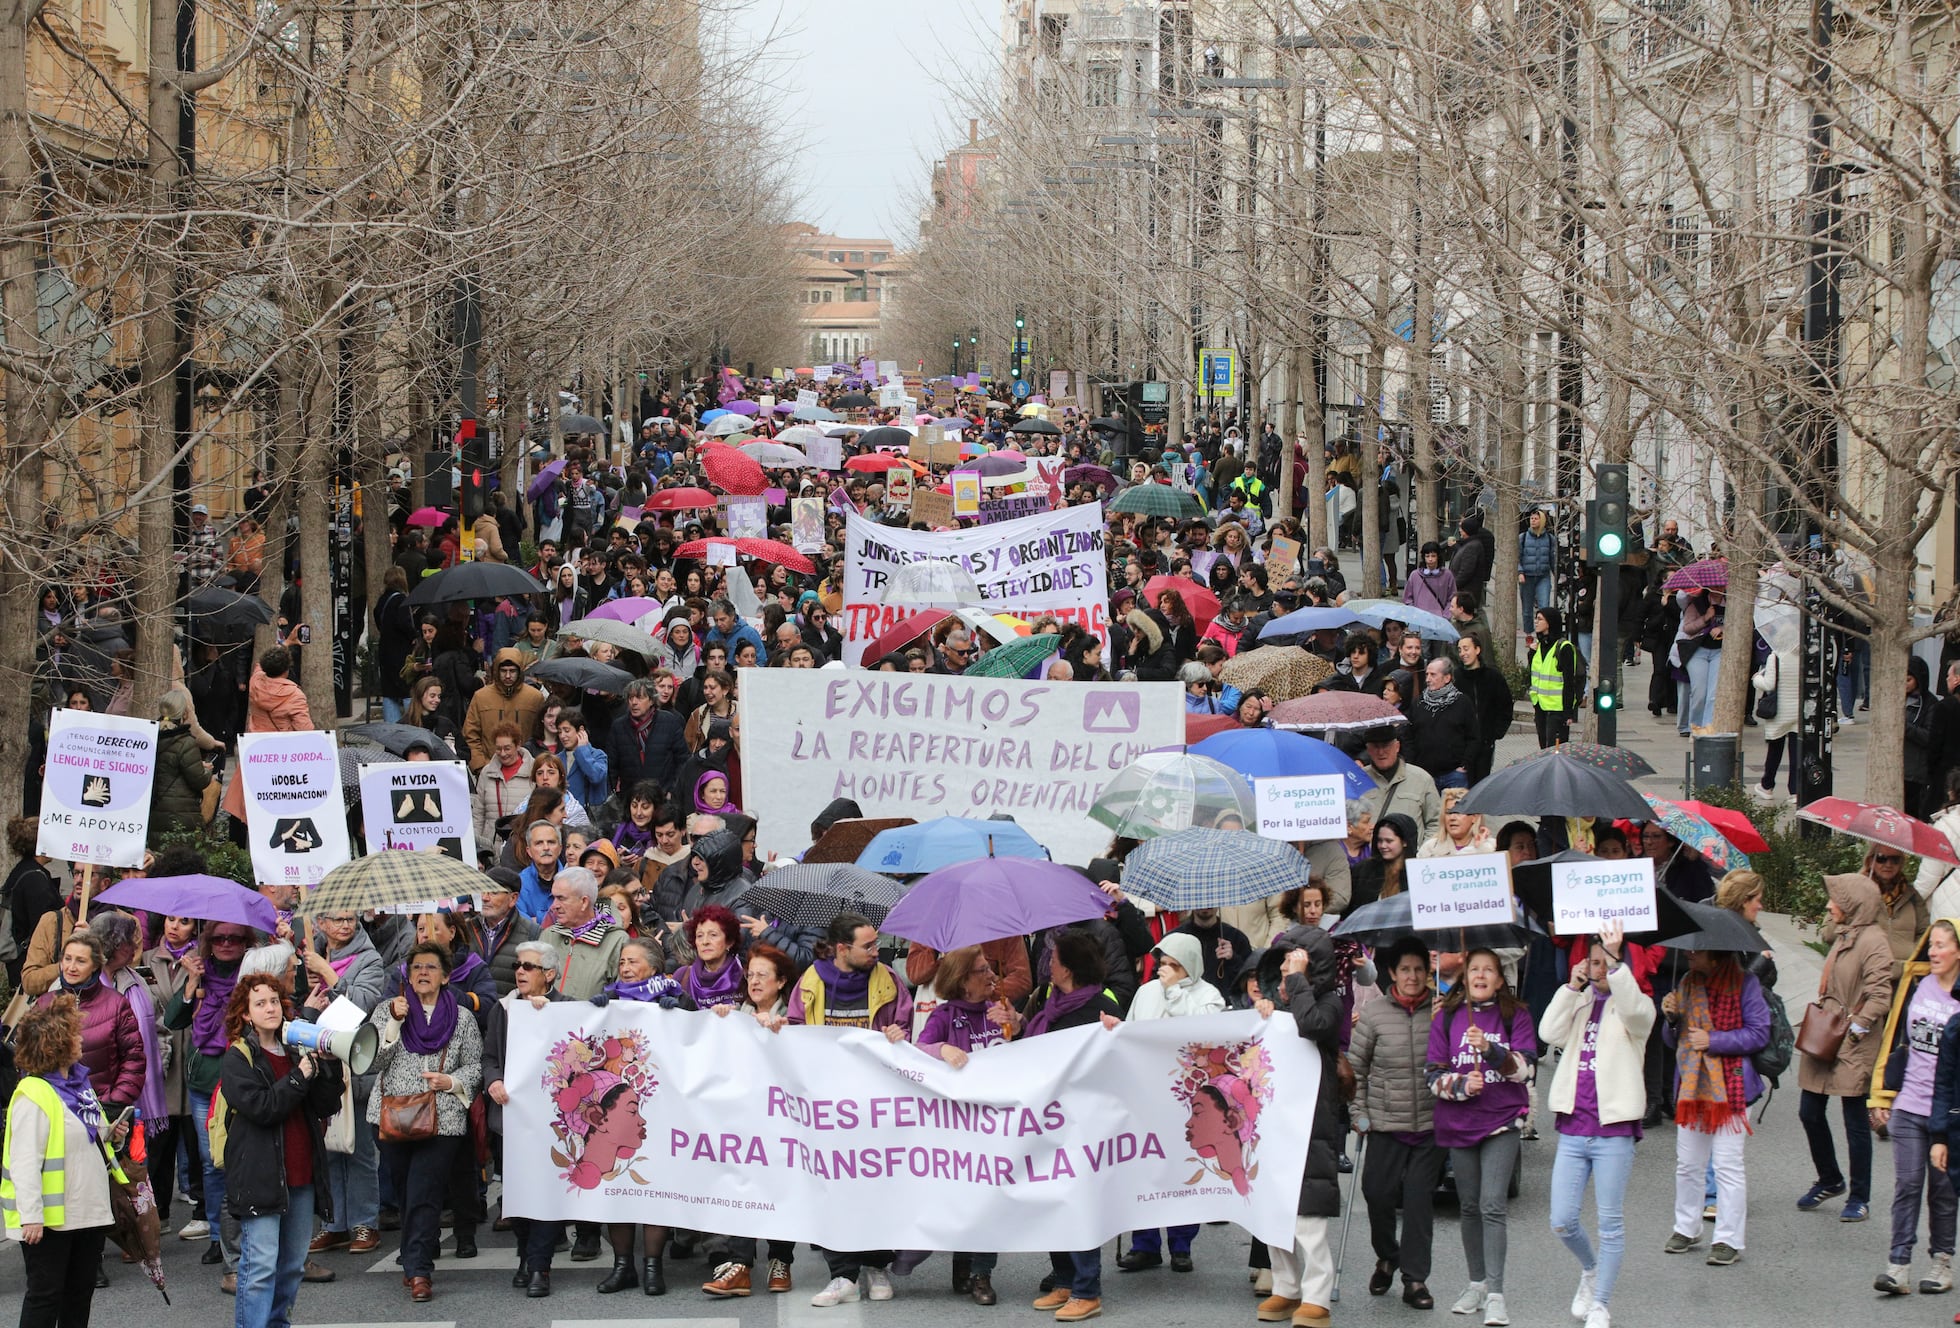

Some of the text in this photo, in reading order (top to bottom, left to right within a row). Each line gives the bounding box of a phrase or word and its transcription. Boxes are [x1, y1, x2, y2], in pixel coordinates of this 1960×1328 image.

[1015, 499, 1027, 510] EN
[1033, 496, 1046, 507] UN
[988, 547, 1000, 572] Y
[1008, 529, 1104, 567] ORGANIZADAS
[825, 679, 1051, 727] EXIGIMOS
[97, 735, 149, 750] DERECHO
[67, 744, 122, 757] COMUNICARME
[790, 730, 832, 760] LA
[849, 730, 1033, 769] REAPERTURA
[1049, 739, 1099, 772] DEL
[53, 753, 149, 775] LENGUA DE SIGNOS!
[248, 753, 279, 763] MUJER
[281, 754, 288, 763] Y
[392, 774, 437, 786] MI VIDA
[832, 769, 1104, 813] MONTES ORIENTALE
[1283, 787, 1335, 799] aspaym
[1294, 798, 1336, 809] granada
[43, 812, 143, 835] ¿ME APOYAS?
[1263, 816, 1341, 829] Por la Igualdad
[399, 826, 454, 835] CONTROLO
[71, 842, 89, 854] 8M
[284, 866, 300, 876] 8M
[1438, 867, 1497, 880] aspaym
[1451, 879, 1498, 892] granada
[1584, 872, 1643, 886] aspaym
[1596, 885, 1644, 897] granada
[1417, 898, 1505, 914] Por la Igualdad
[1561, 905, 1650, 919] Por la Igualdad
[767, 1085, 1065, 1137] REDES FEMINISTAS
[670, 1128, 1166, 1186] PARA TRANSFORMAR LA VIDA
[604, 1187, 643, 1197] ESPACIO
[644, 1189, 689, 1203] FEMINISMO
[690, 1195, 730, 1207] UNITARIO
[731, 1200, 743, 1209] DE
[1137, 1187, 1233, 1203] PLATAFORMA 8M/25N
